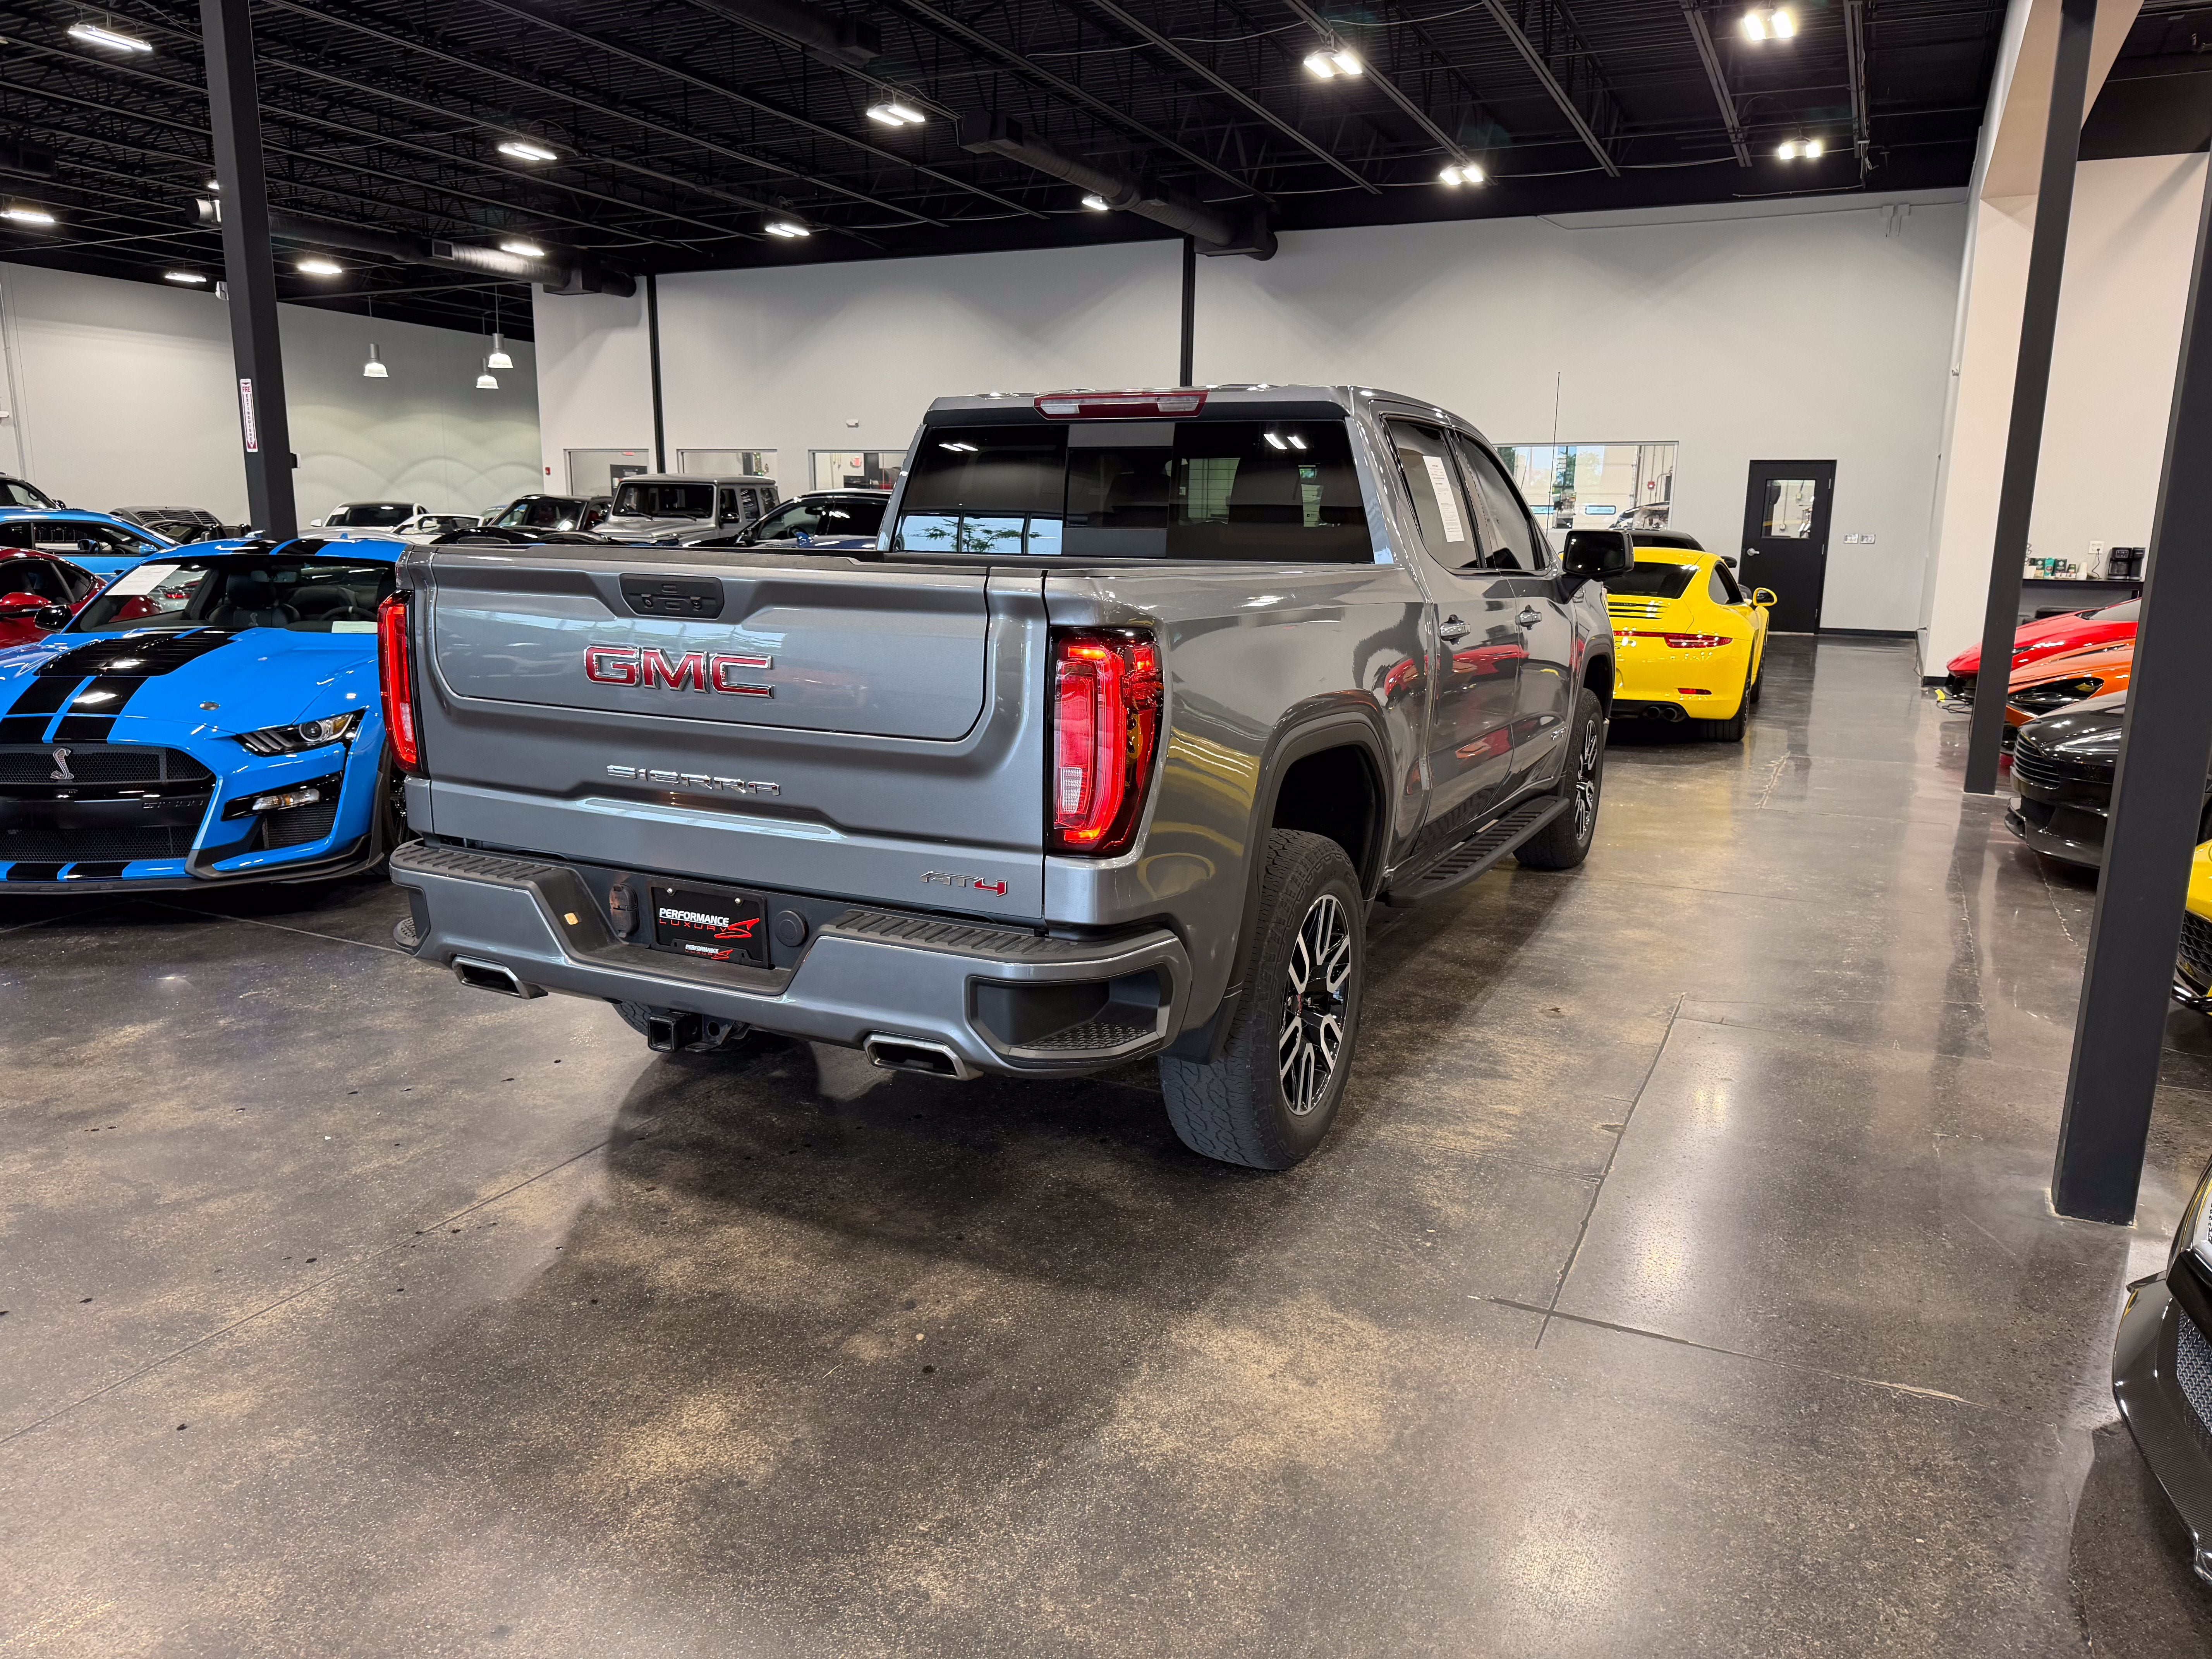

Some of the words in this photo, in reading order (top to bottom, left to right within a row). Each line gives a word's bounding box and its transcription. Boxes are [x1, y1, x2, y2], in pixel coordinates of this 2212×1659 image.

[584, 644, 775, 699] GMC
[607, 764, 781, 797] SIERRA
[920, 871, 1008, 897] AT4
[659, 908, 729, 926] PERFORMANCE
[659, 918, 727, 932] LUXURY
[685, 944, 719, 953] PERFORMANCE
